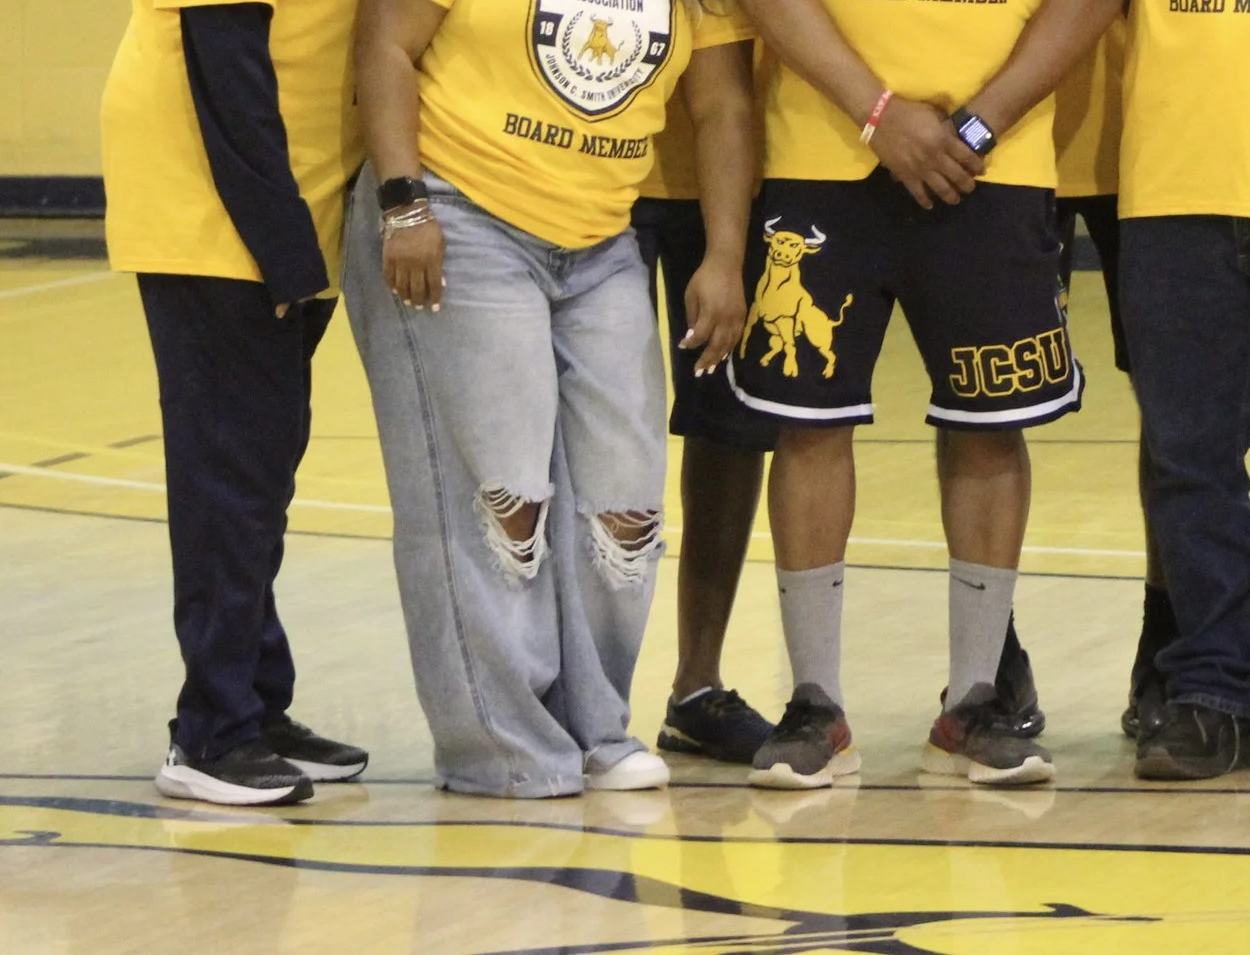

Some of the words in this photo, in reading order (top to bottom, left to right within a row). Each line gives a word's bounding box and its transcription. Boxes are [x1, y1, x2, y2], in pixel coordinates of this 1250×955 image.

[540, 21, 555, 36] 18
[650, 42, 665, 56] 67
[502, 113, 574, 150] BOARD
[949, 327, 1070, 398] JCSU
